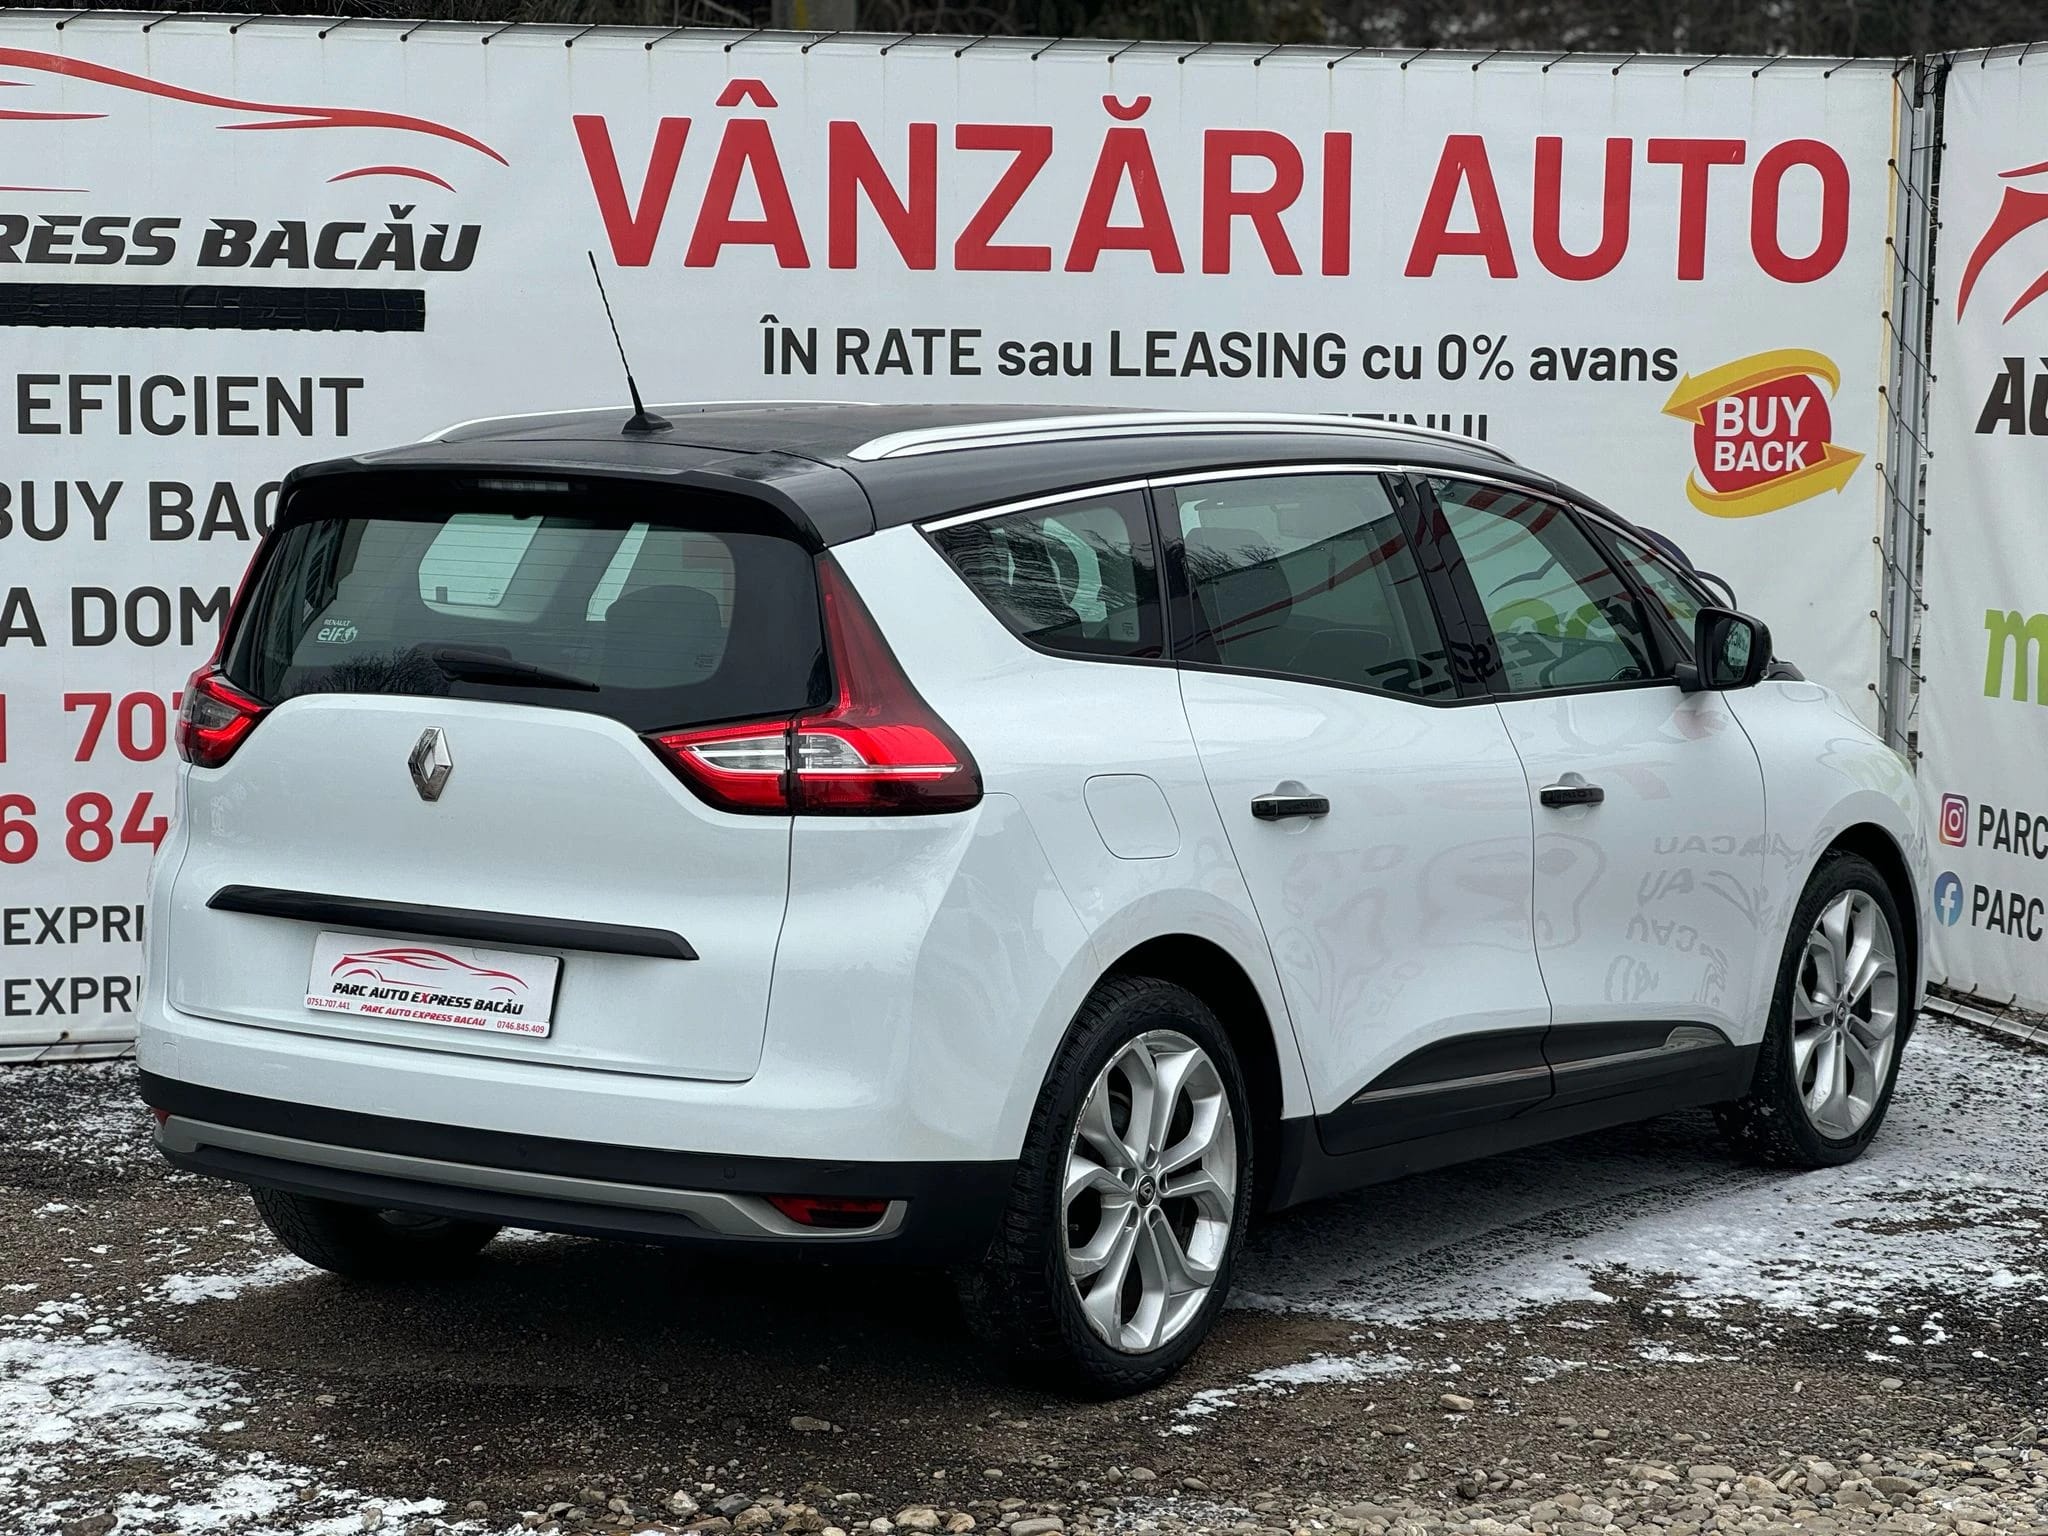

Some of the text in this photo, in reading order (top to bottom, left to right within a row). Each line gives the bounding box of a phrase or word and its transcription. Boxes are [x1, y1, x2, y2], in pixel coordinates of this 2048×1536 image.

[572, 78, 1851, 284] VÂNZĂRI AUTO
[196, 204, 482, 272] BACĂU
[759, 314, 1679, 383] ÎN RATE sau LEASING cu 0% avans
[16, 373, 364, 437] EFICIENT
[1714, 396, 1811, 438] BUY
[1713, 441, 1809, 473] BACK
[0, 480, 124, 541] UY
[1978, 804, 2048, 860] PARC
[1971, 884, 2045, 942] PARC
[332, 982, 524, 1015] PARC AUTO EXPRESS BACĂU
[359, 1004, 385, 1014] PARC
[385, 1007, 411, 1017] AUTO
[412, 1010, 454, 1023] EXPRESS
[454, 1015, 487, 1026] BACAU
